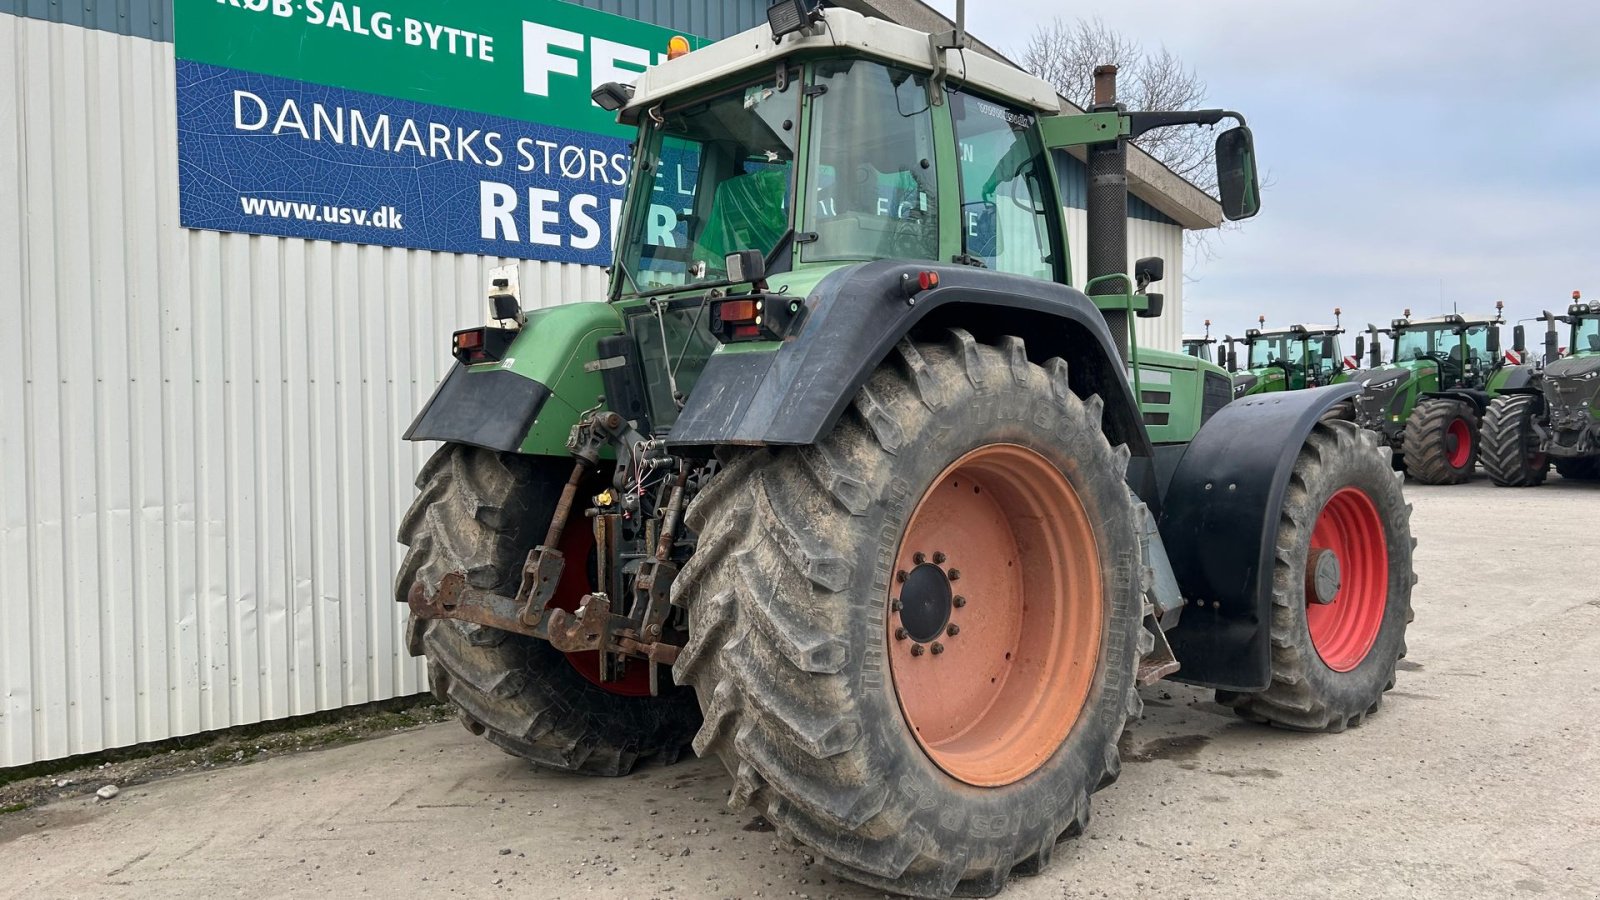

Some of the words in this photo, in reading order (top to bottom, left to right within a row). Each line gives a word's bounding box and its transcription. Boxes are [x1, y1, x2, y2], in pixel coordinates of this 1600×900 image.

[522, 20, 668, 107] FE
[233, 89, 502, 168] DANMARKS
[240, 195, 403, 231] www.usv.dk
[858, 476, 908, 696] TRELLEBORG
